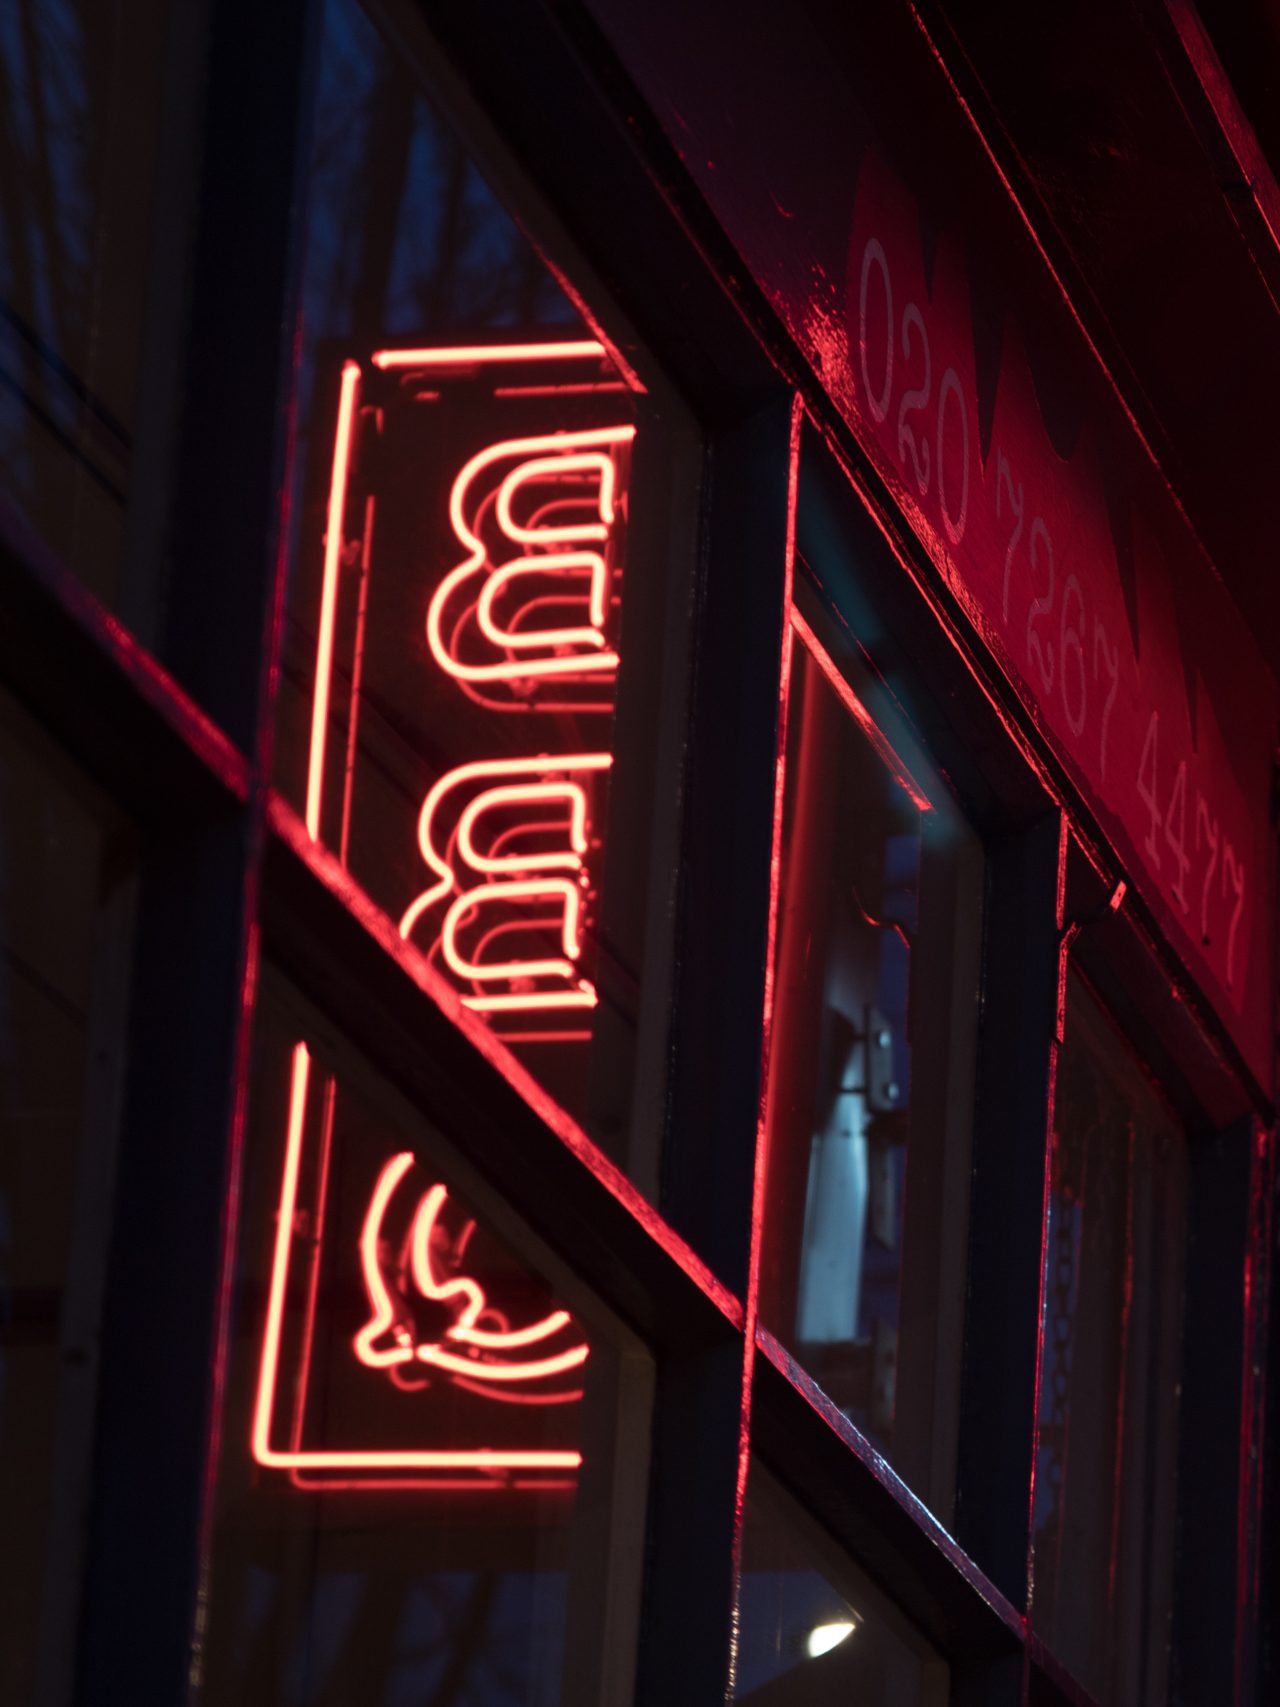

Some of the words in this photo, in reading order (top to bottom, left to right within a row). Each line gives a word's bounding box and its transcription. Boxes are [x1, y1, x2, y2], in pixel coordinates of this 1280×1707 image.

[859, 237, 970, 546] 020
[997, 448, 1119, 787] 7267
[1137, 710, 1245, 987] 4477
